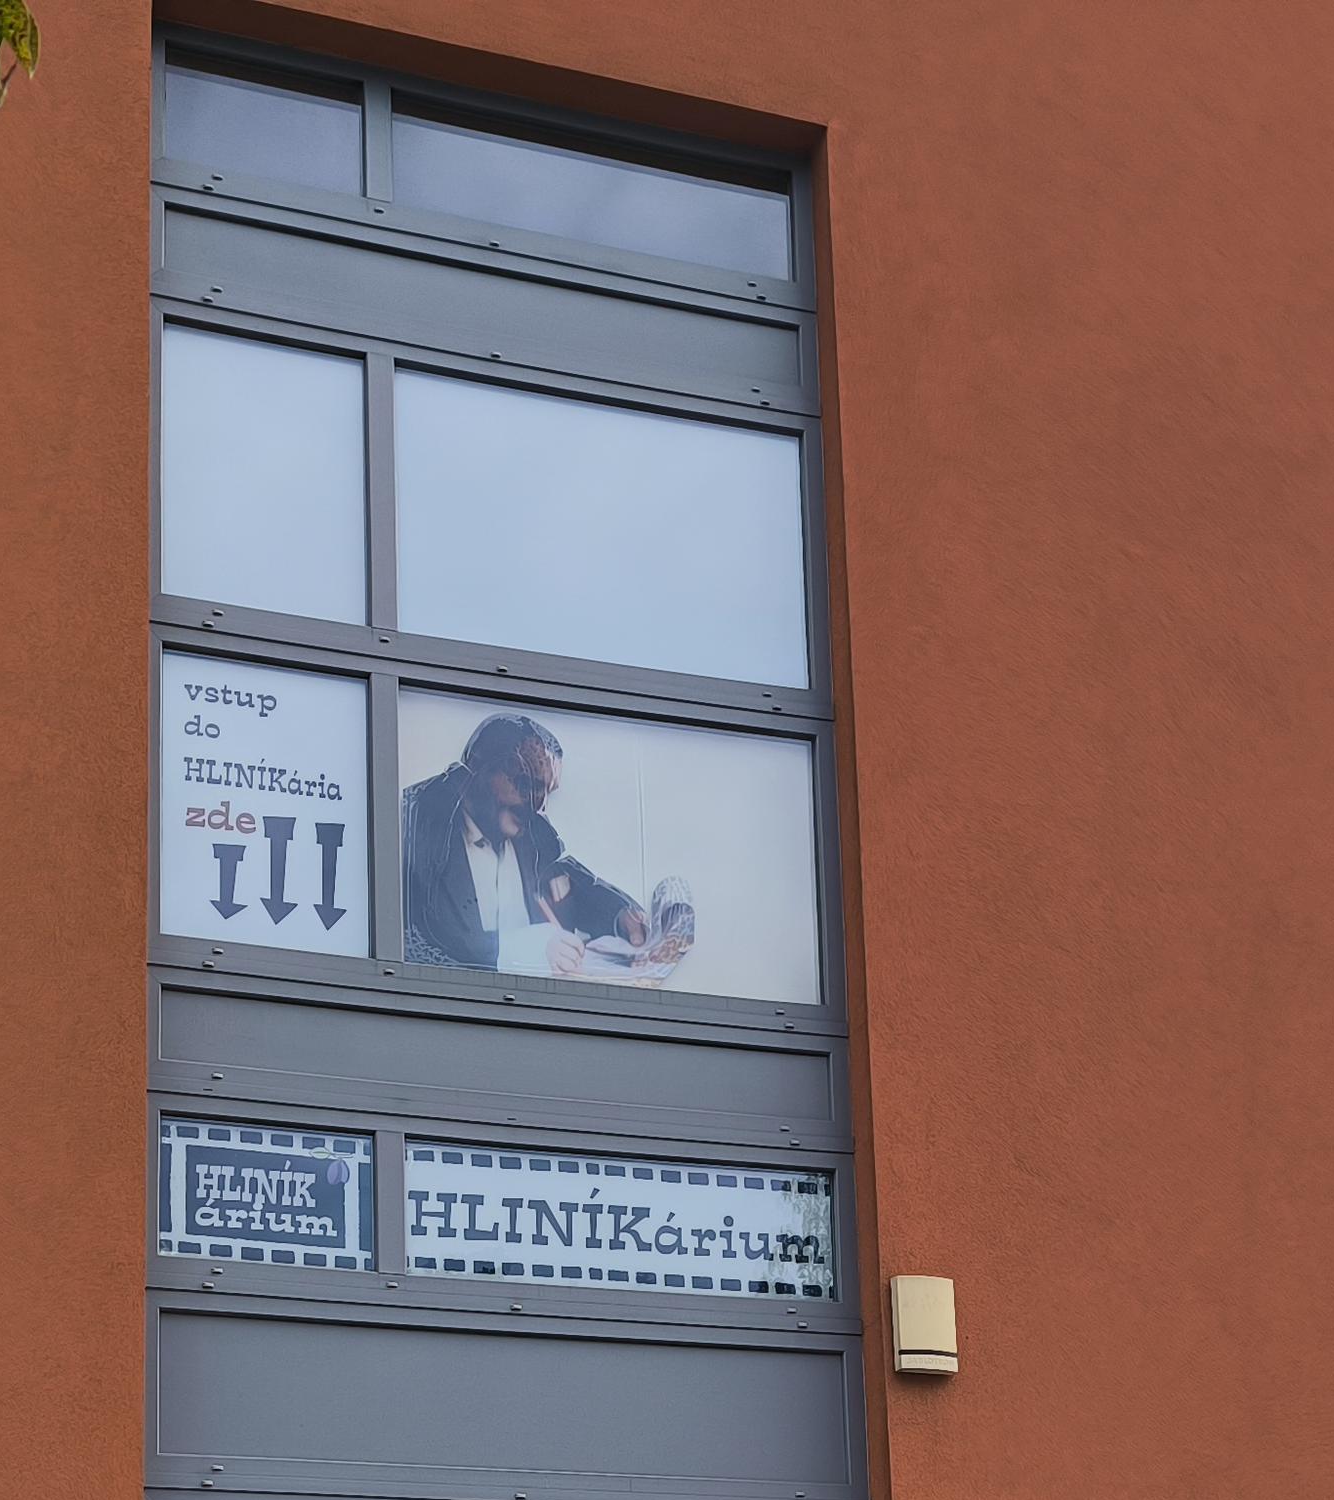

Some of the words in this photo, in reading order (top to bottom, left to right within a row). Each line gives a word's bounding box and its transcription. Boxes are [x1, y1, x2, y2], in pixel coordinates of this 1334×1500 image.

[184, 681, 278, 716] vstup
[184, 714, 221, 740] do
[183, 756, 343, 801] HLINÍKária
[184, 801, 257, 834] zde
[195, 1160, 316, 1208] HLINÍK
[194, 1199, 338, 1237] árium
[409, 1188, 825, 1266] HLINÍKárium
